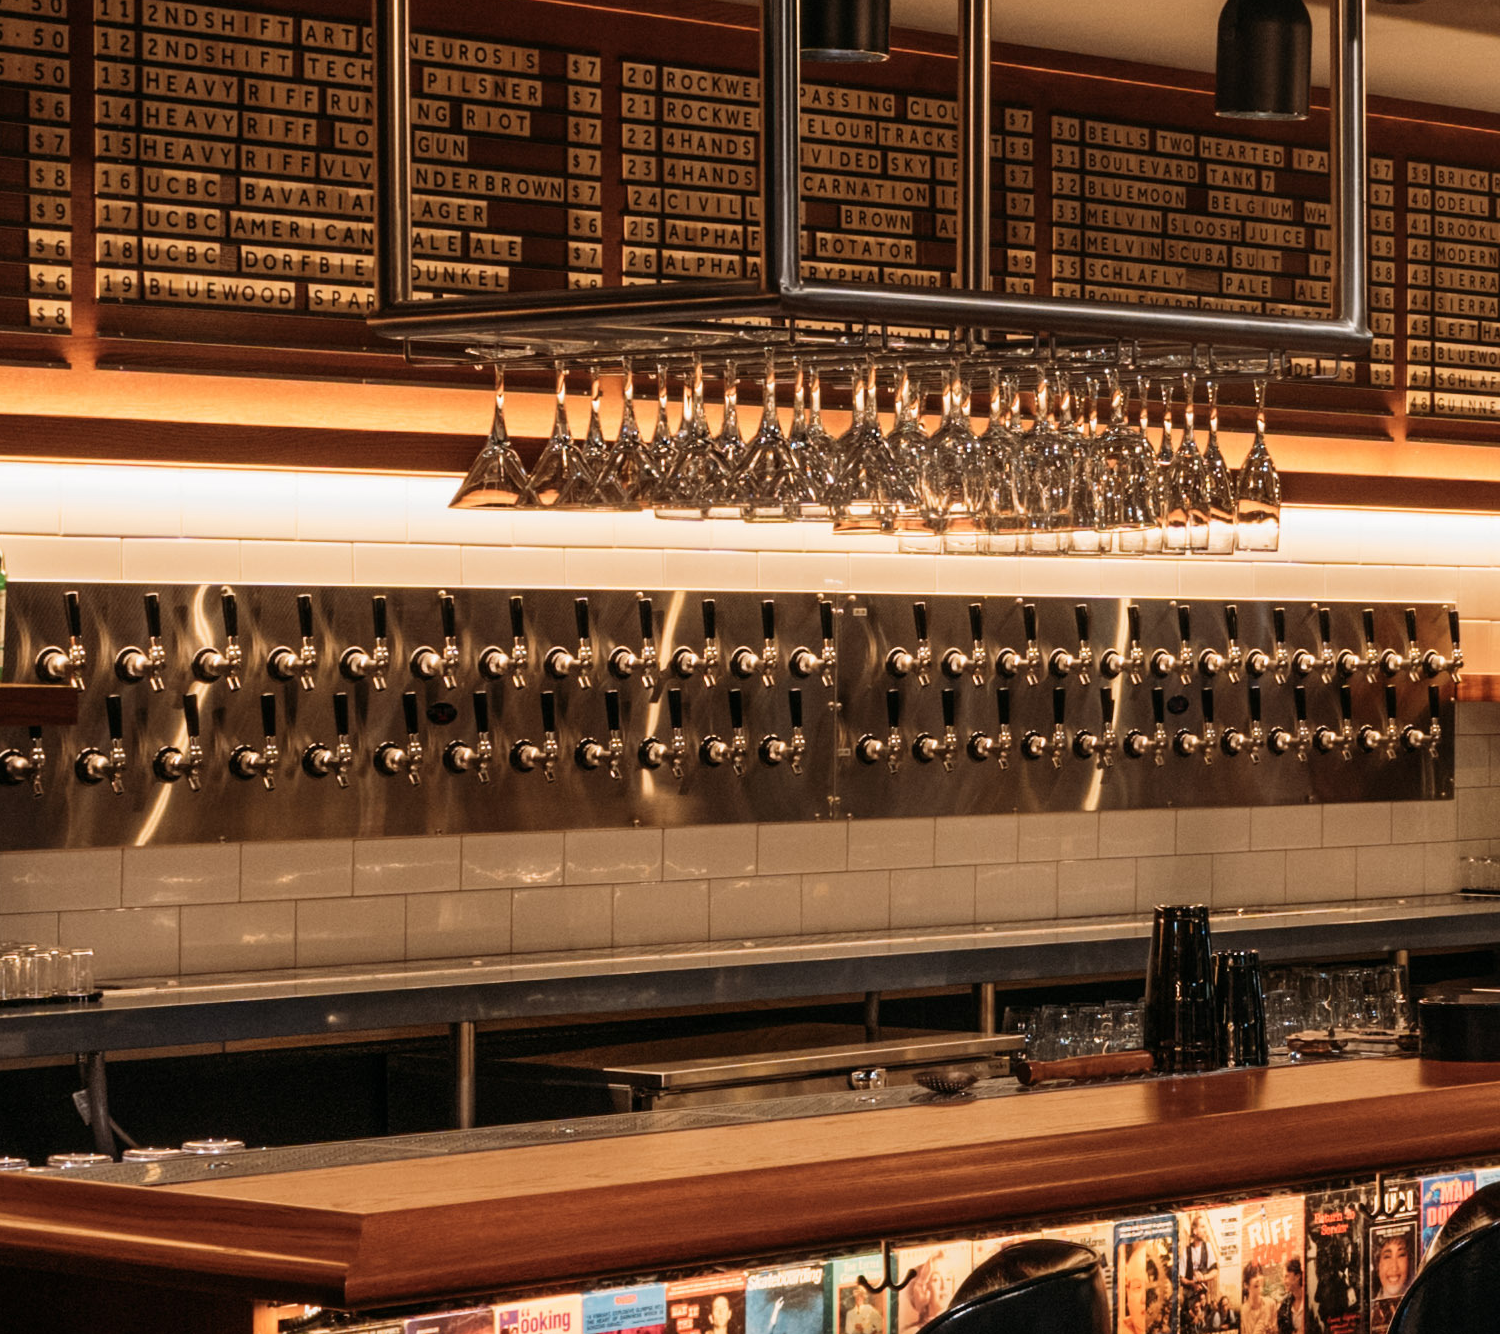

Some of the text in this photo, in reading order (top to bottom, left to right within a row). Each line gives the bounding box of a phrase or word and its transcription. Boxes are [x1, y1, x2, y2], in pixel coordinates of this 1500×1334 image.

[101, 32, 131, 52] 12
[147, 37, 291, 66] 2NDSHIFT
[426, 72, 539, 102] PILSNER
[572, 91, 598, 108] $7
[34, 95, 65, 118] $6
[34, 132, 66, 153] $7
[1056, 121, 1392, 178] 30 BELLS TWO HEARTED IPA $7
[627, 127, 1031, 186] 22 4HANDS IVIDED SKY $7
[35, 166, 67, 188] $8
[1056, 147, 1392, 203] 31 BOULEVARD TANK 7 $7
[1410, 167, 1429, 183] 39
[1437, 169, 1488, 189] BRICK
[35, 200, 67, 223] $9
[35, 236, 67, 257] $6
[35, 271, 67, 293] $6
[35, 305, 68, 327] $8
[1410, 318, 1429, 334] 45
[1437, 322, 1477, 338] LEFT
[1409, 396, 1428, 412] 48
[1439, 1180, 1475, 1205] MAN
[1250, 1218, 1293, 1248] RIFF
[748, 1266, 823, 1290] Skateboarding
